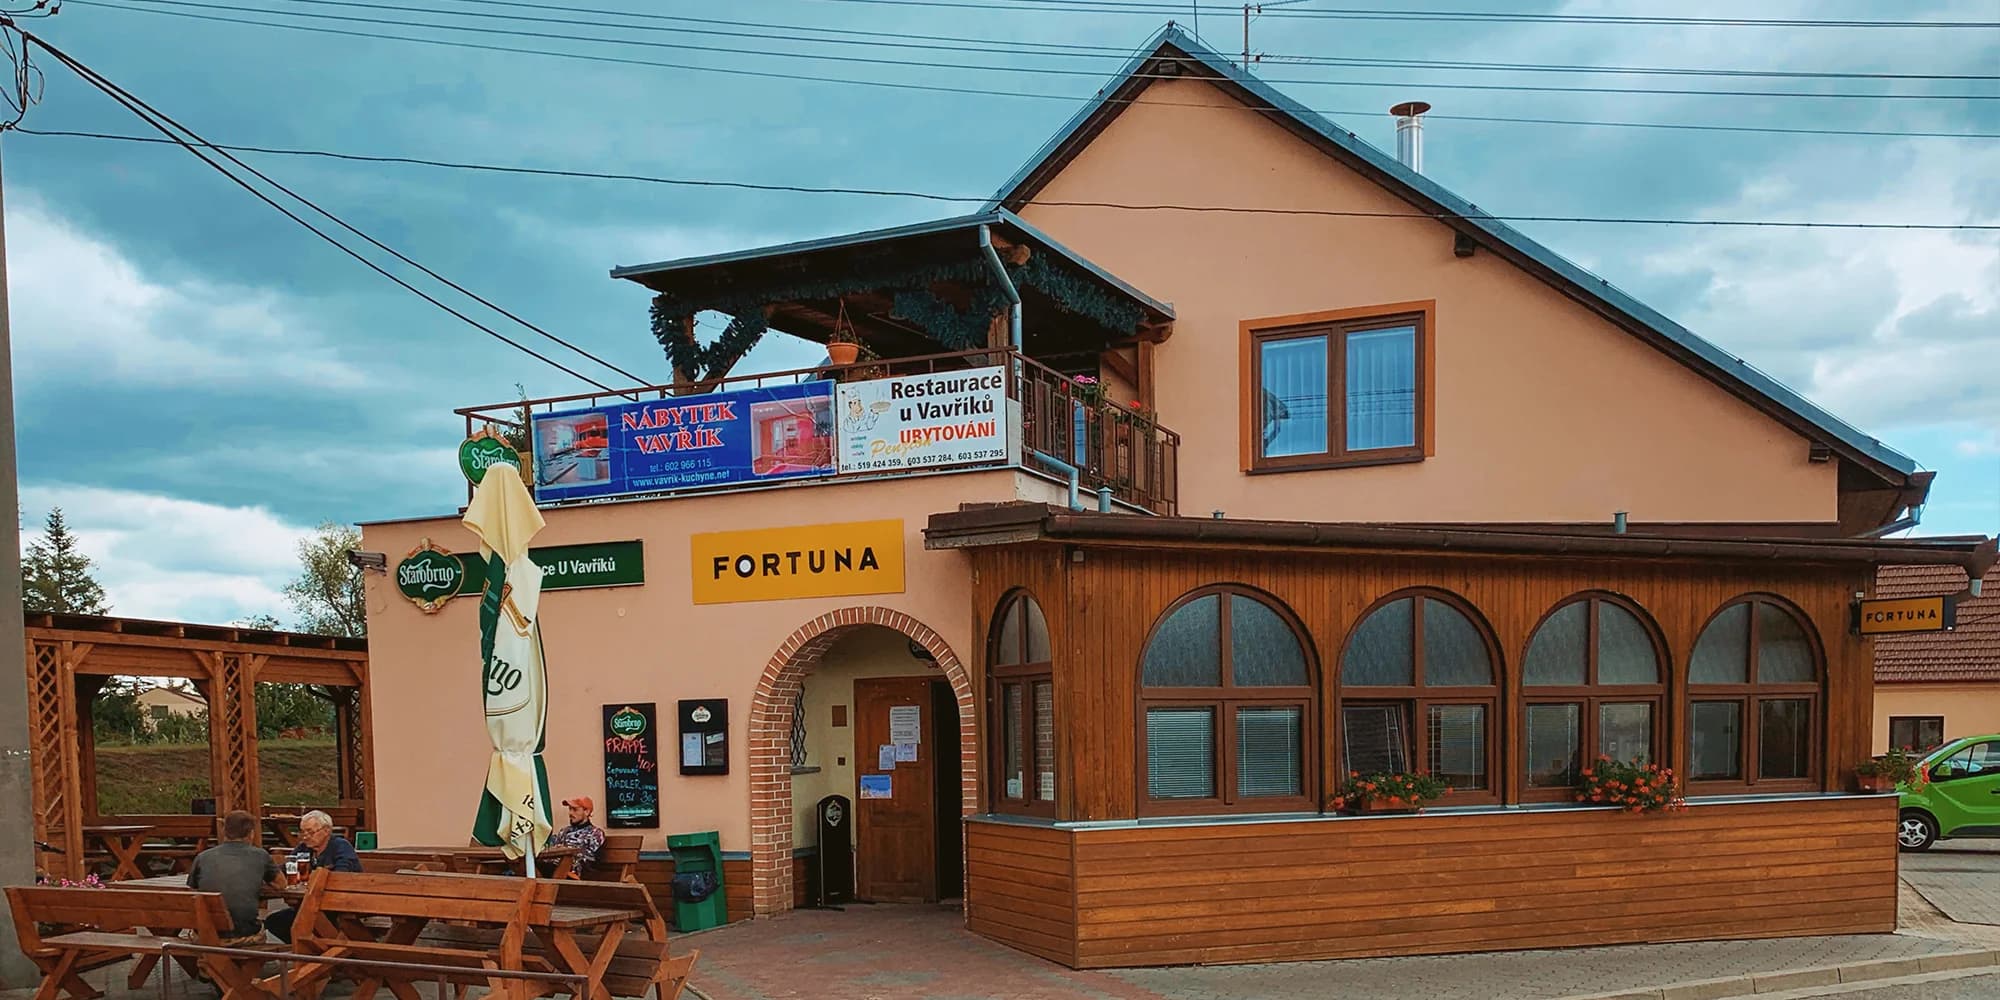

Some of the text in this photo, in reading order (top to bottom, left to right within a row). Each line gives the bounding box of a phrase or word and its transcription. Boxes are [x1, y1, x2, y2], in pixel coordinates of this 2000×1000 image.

[891, 374, 1002, 400] Restaurace
[620, 401, 738, 432] NÁBYTEK
[900, 394, 993, 421] u Vavříků
[635, 426, 726, 455] VAVŘÍK
[900, 418, 996, 444] UBYTOVÁNÍ
[664, 461, 679, 471] 602
[680, 460, 696, 470] 966
[697, 458, 712, 468] 115
[857, 461, 871, 470] 519
[872, 460, 886, 468] 424
[907, 455, 921, 465] 603
[923, 454, 937, 464] 537
[958, 452, 972, 461] 603
[973, 450, 987, 459] 537
[989, 449, 1004, 458] 295
[632, 470, 730, 487] www.vavrik-kuchyne.net
[400, 558, 454, 592] Starobrno
[558, 561, 567, 575] U
[570, 557, 616, 574] Vavříků
[713, 547, 879, 579] FORTUNA
[1865, 609, 1937, 623] FORTUNA
